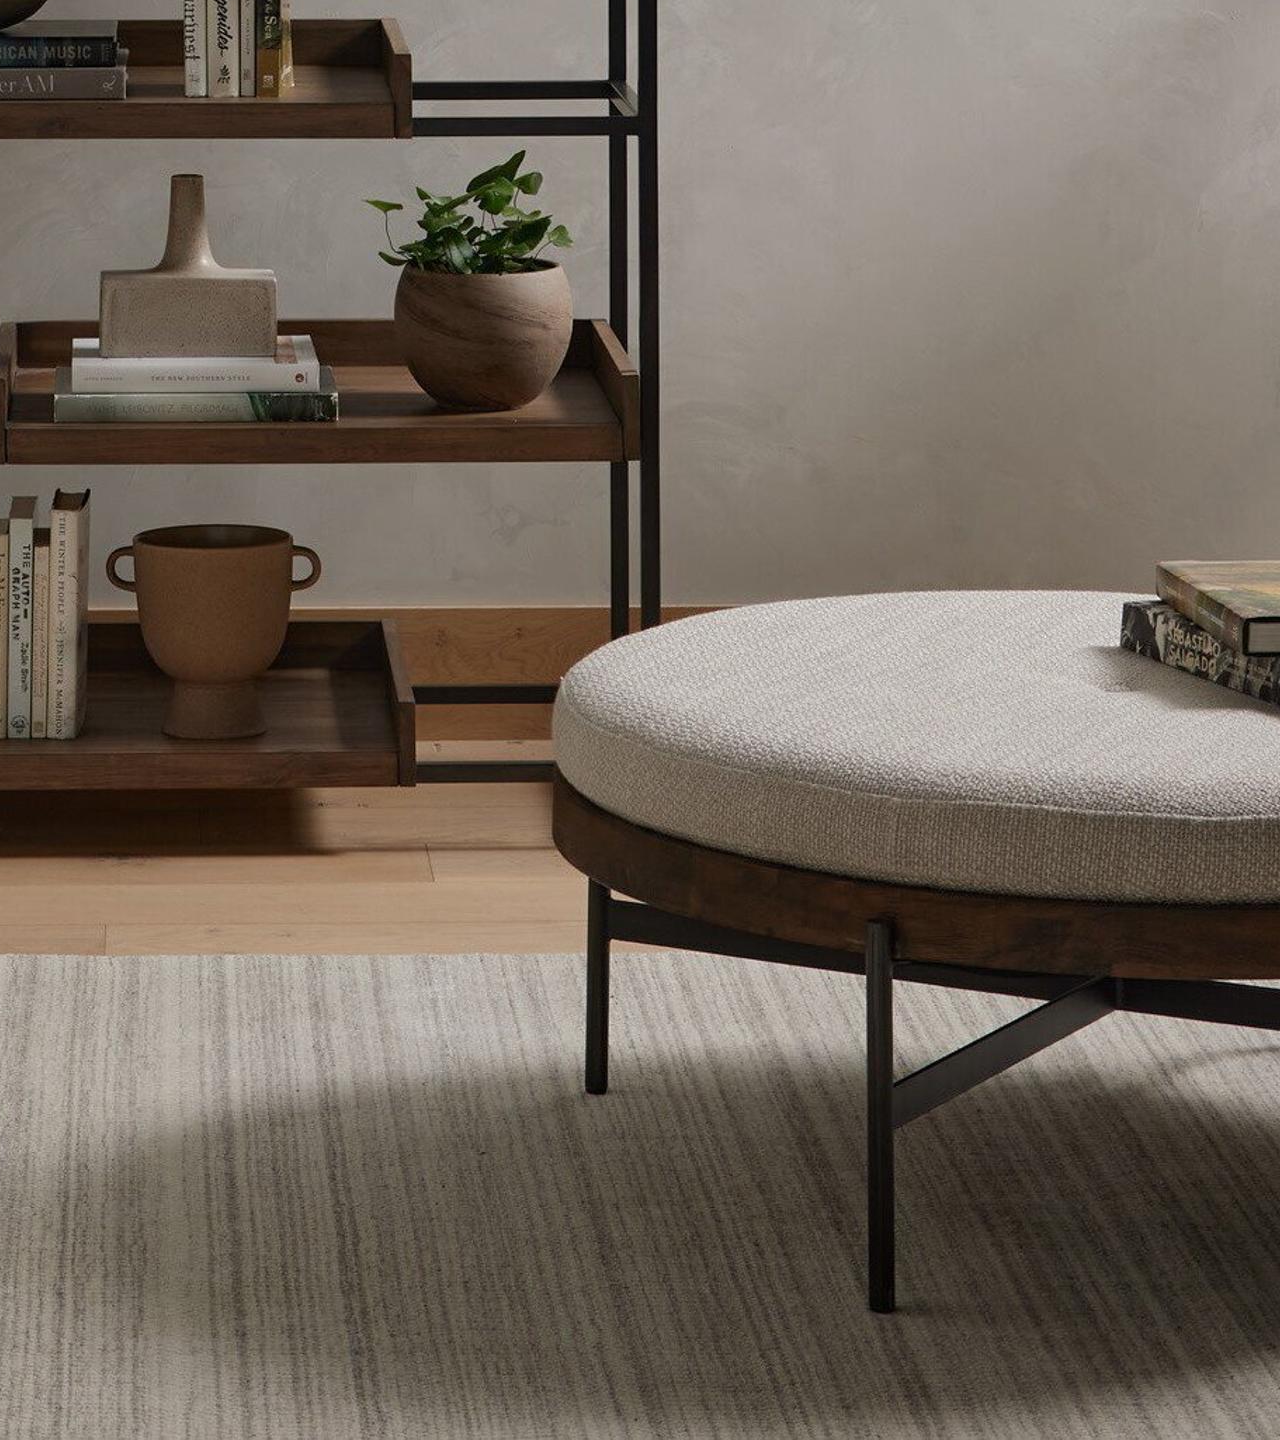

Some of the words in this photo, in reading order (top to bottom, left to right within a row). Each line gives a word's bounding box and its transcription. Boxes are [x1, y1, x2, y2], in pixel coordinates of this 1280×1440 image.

[264, 15, 277, 40] Sea
[44, 45, 92, 60] MUSIC
[21, 74, 54, 92] AM
[58, 516, 66, 536] THE
[22, 544, 30, 568] THE
[57, 540, 66, 576] WINTER
[12, 567, 20, 610] GRAPH
[56, 580, 64, 615] PEOPLE
[55, 638, 64, 685] JENNIFER
